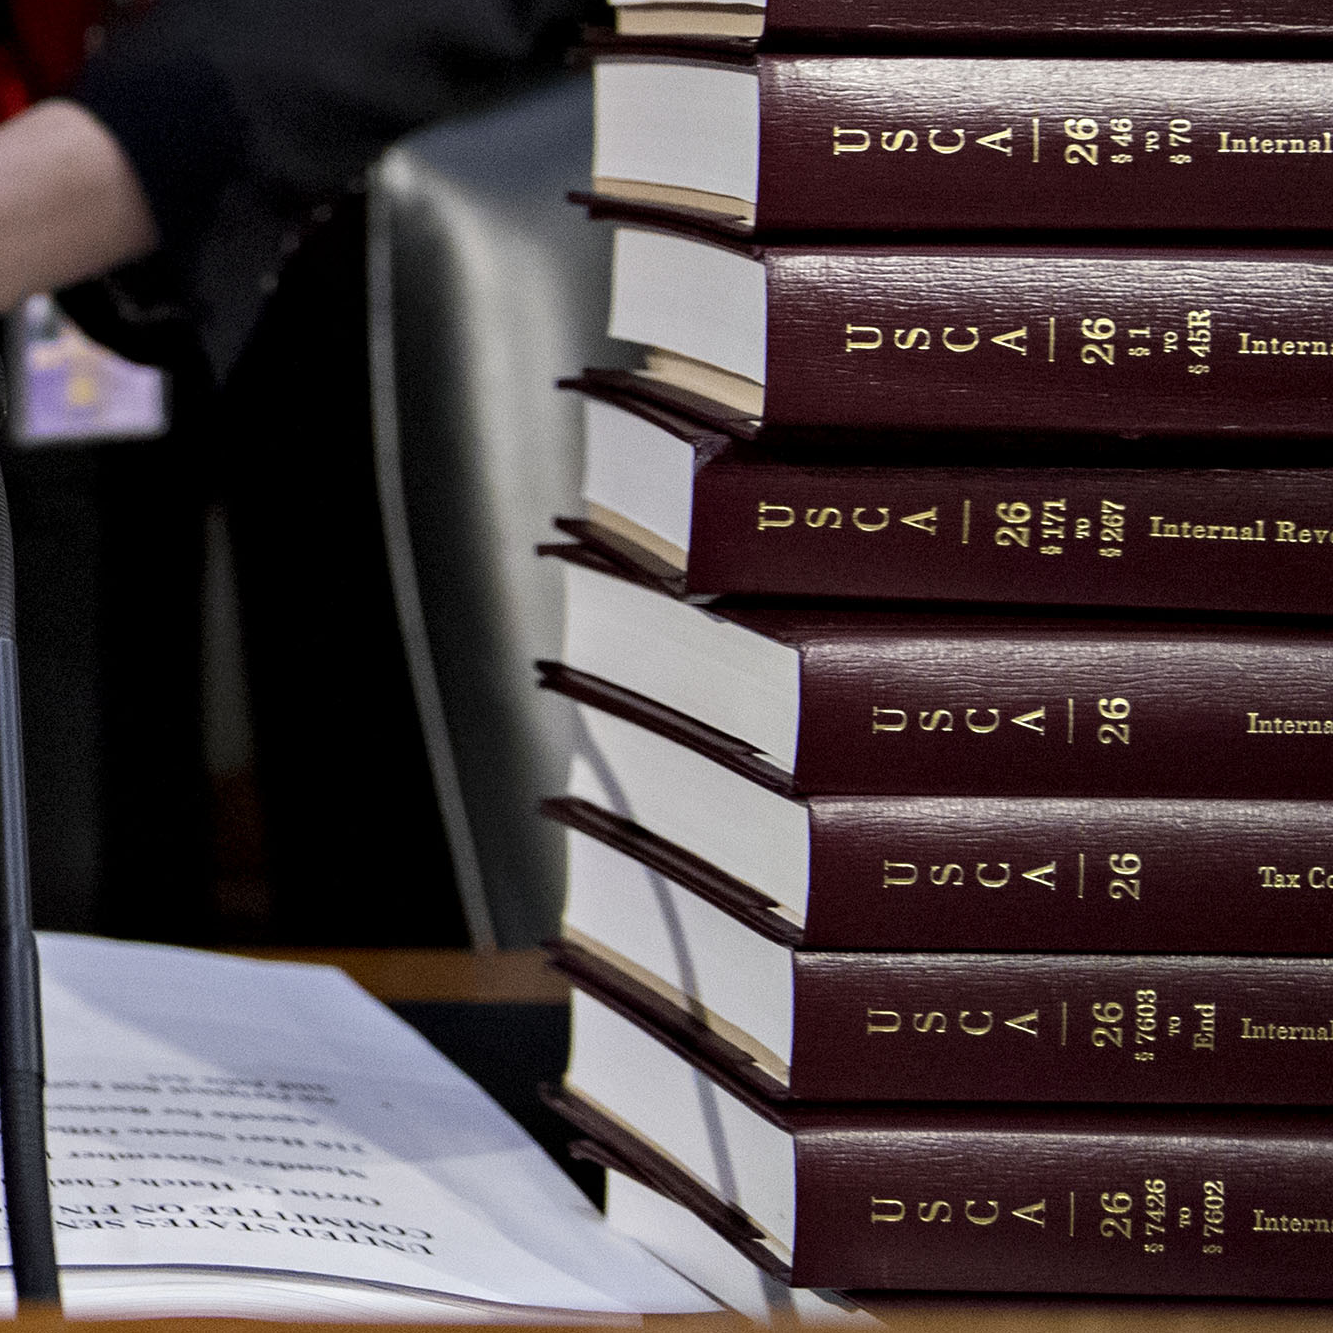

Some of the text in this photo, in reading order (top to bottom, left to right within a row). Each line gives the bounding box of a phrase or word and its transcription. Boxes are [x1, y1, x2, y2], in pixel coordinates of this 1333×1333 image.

[1063, 118, 1099, 166] 26
[1217, 131, 1333, 154] Internal
[1079, 317, 1116, 366] 26
[1237, 332, 1333, 356] Intern
[995, 501, 1032, 548] 26
[1148, 515, 1267, 542] Internal
[1097, 697, 1130, 745] 26
[1108, 852, 1142, 901] 26
[1258, 866, 1301, 889] Tax
[1092, 1001, 1124, 1048] 26
[1193, 1003, 1215, 1048] End
[129, 1204, 186, 1216] ON
[135, 1217, 280, 1235] STATES
[195, 1205, 434, 1242] COMMITTEE
[1100, 1192, 1133, 1239] 26
[1252, 1209, 1333, 1233] Intern
[289, 1227, 435, 1257] UNITED
